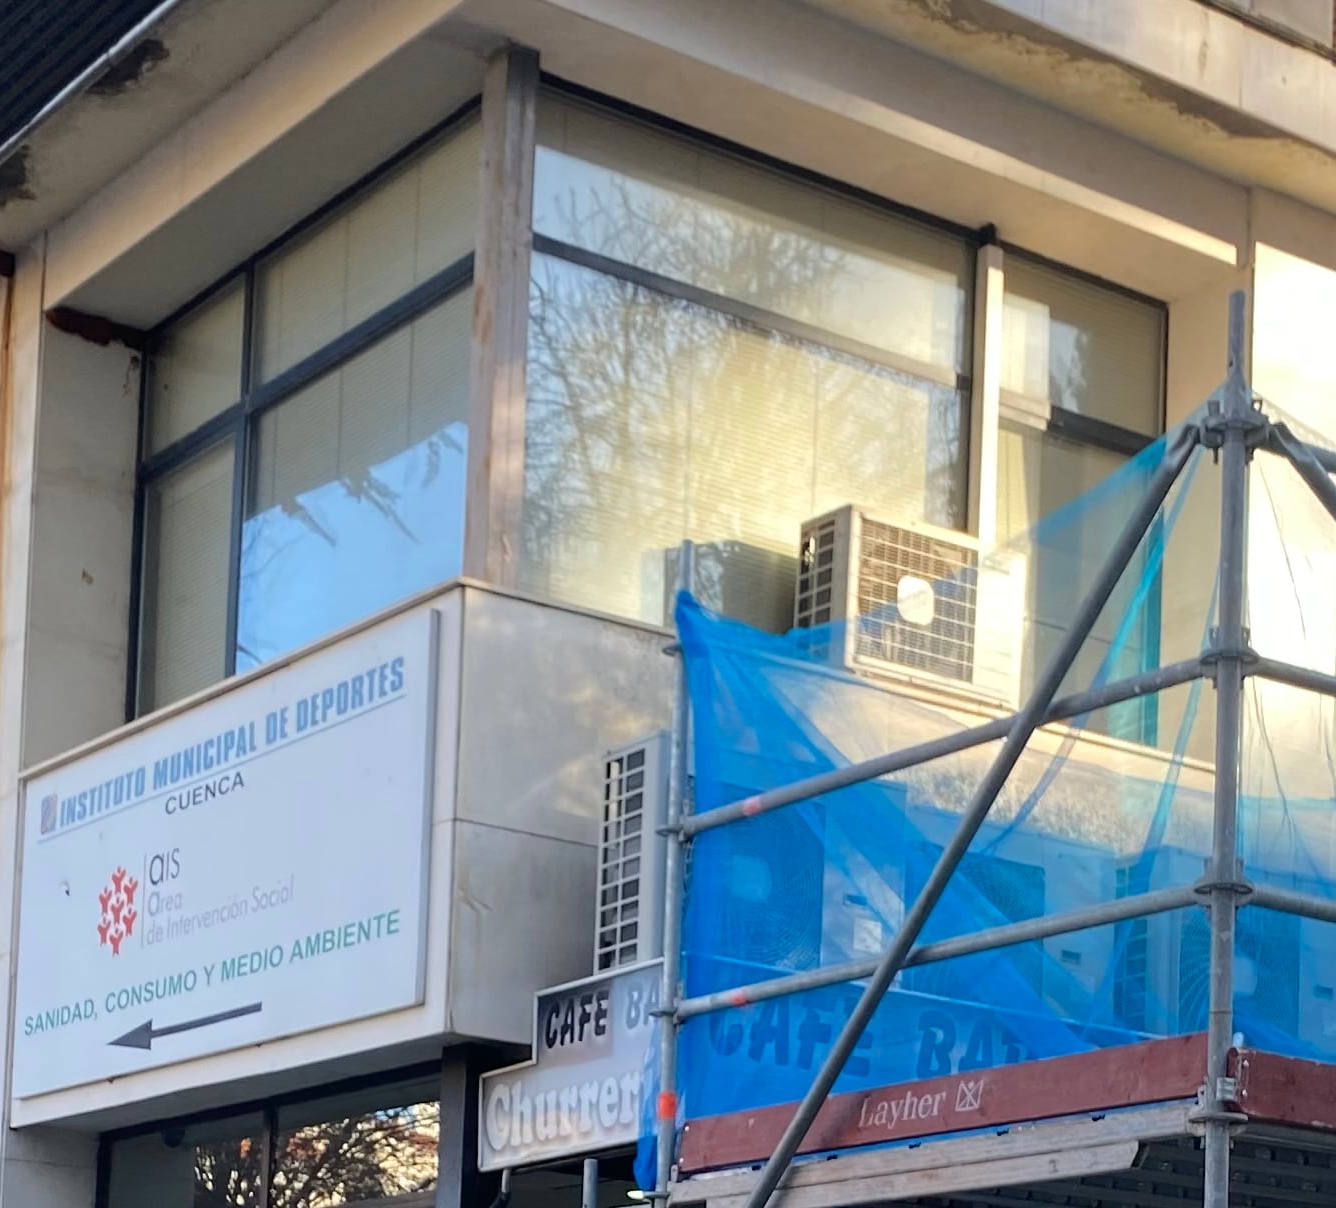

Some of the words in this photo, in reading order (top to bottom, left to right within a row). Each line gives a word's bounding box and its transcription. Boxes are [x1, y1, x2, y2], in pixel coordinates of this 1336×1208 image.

[59, 766, 146, 827] INSTITUTO
[152, 721, 258, 789] MUNICIPAL
[265, 706, 289, 746] DE
[296, 656, 406, 734] DEPORTES
[164, 771, 245, 815] CUENCA
[146, 919, 164, 946] de
[166, 894, 249, 940] Intervención
[251, 873, 295, 913] Social
[23, 998, 99, 1037] SANIDAD,
[104, 968, 197, 1014] CONSUMO
[202, 964, 216, 987] Y
[220, 945, 284, 981] MEDIO
[288, 908, 401, 963] AMBIENTE
[545, 989, 610, 1049] CAFE
[858, 1089, 946, 1130] Layher
